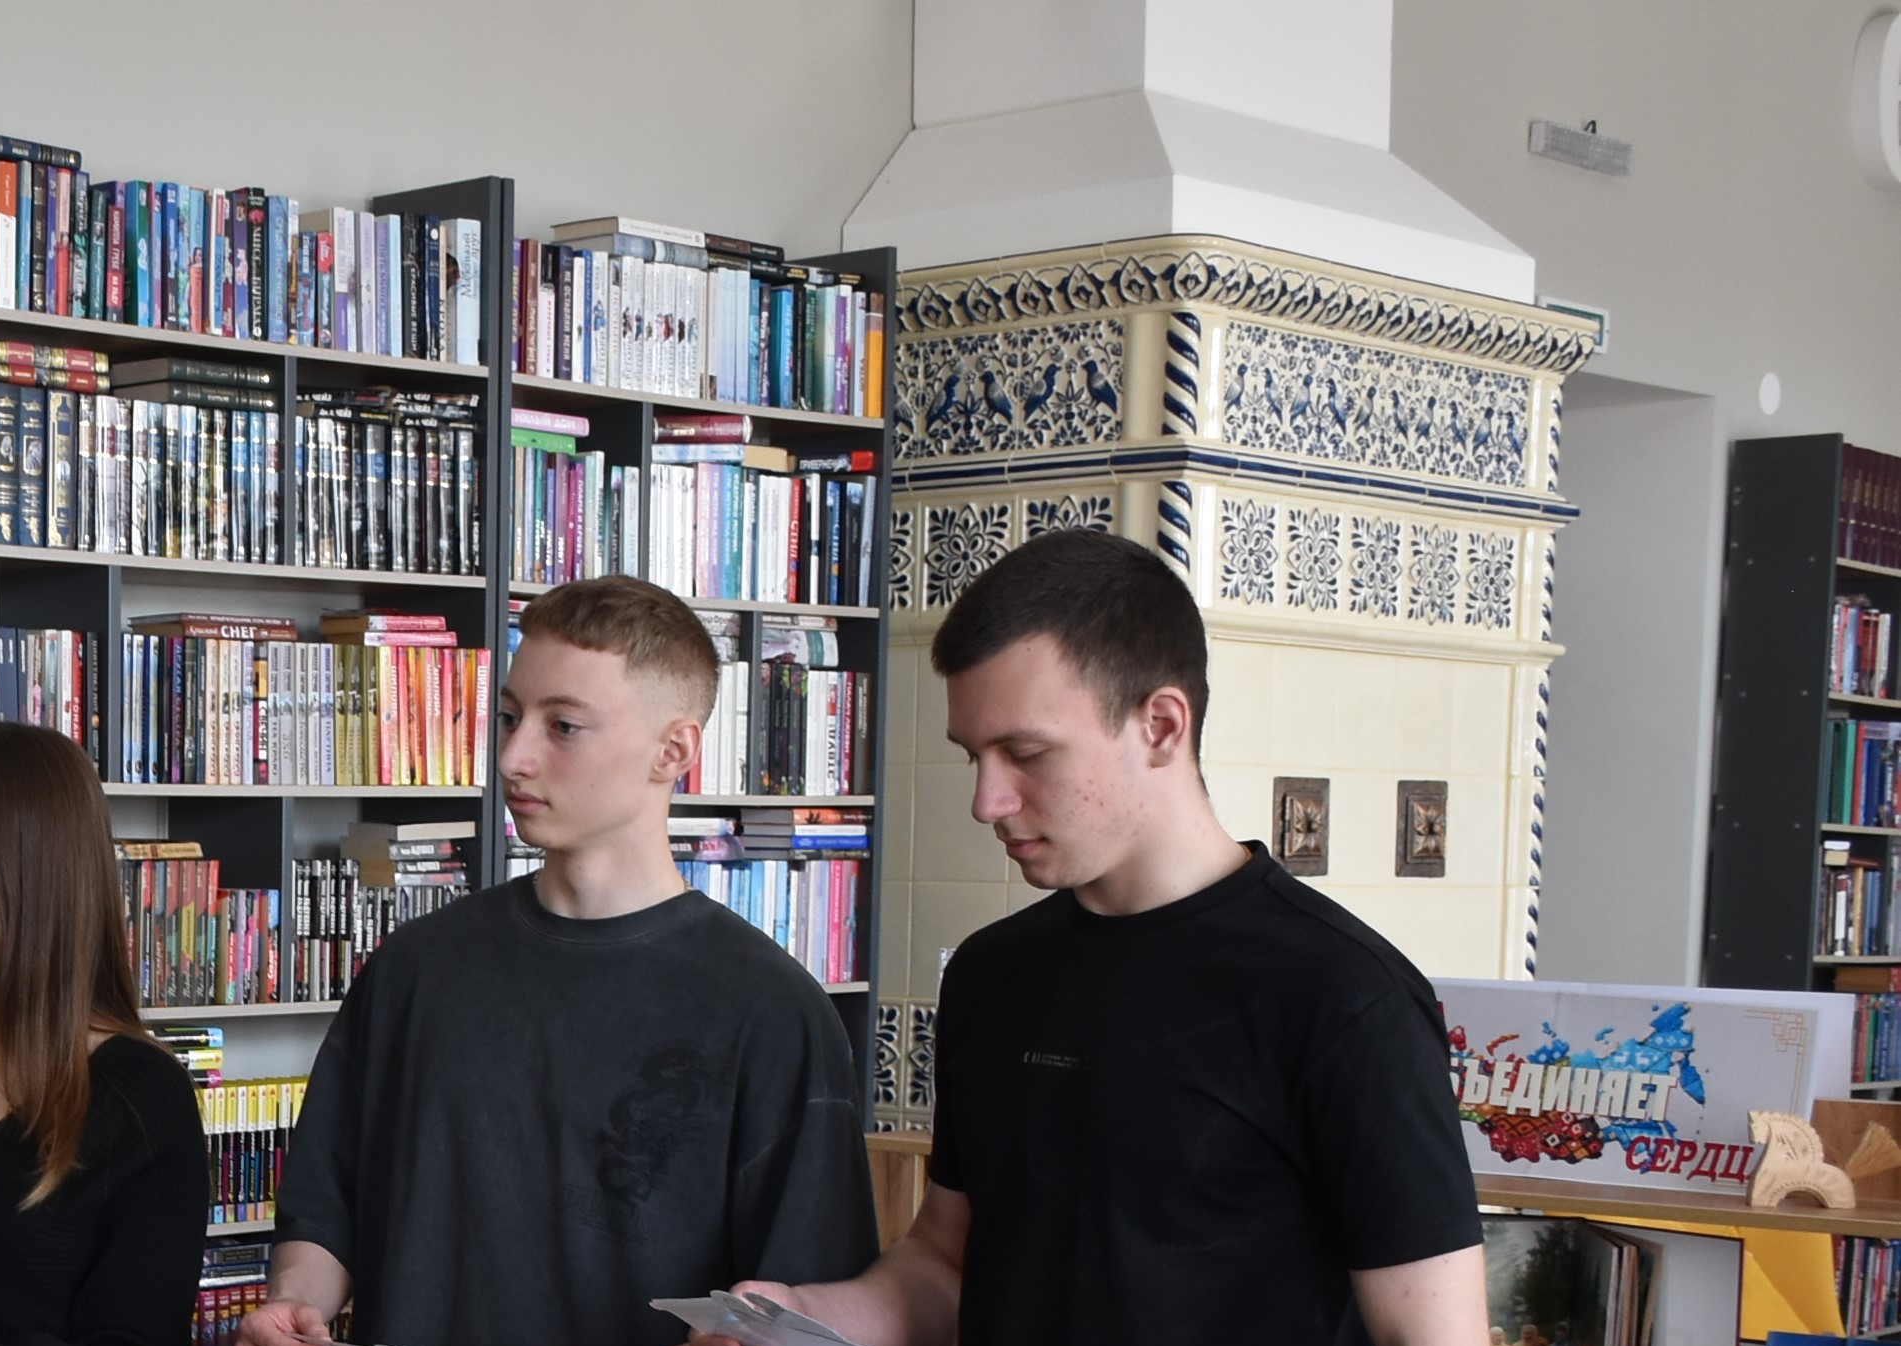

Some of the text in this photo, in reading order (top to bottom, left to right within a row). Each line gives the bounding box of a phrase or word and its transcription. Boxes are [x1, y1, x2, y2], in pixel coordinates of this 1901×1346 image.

[221, 625, 256, 638] СНЕГ
[477, 666, 487, 716] ШИЛОВА
[1451, 1057, 1678, 1121] ЪЕДИНЯЕТ
[1626, 1136, 1755, 1183] СЕРДЦ
